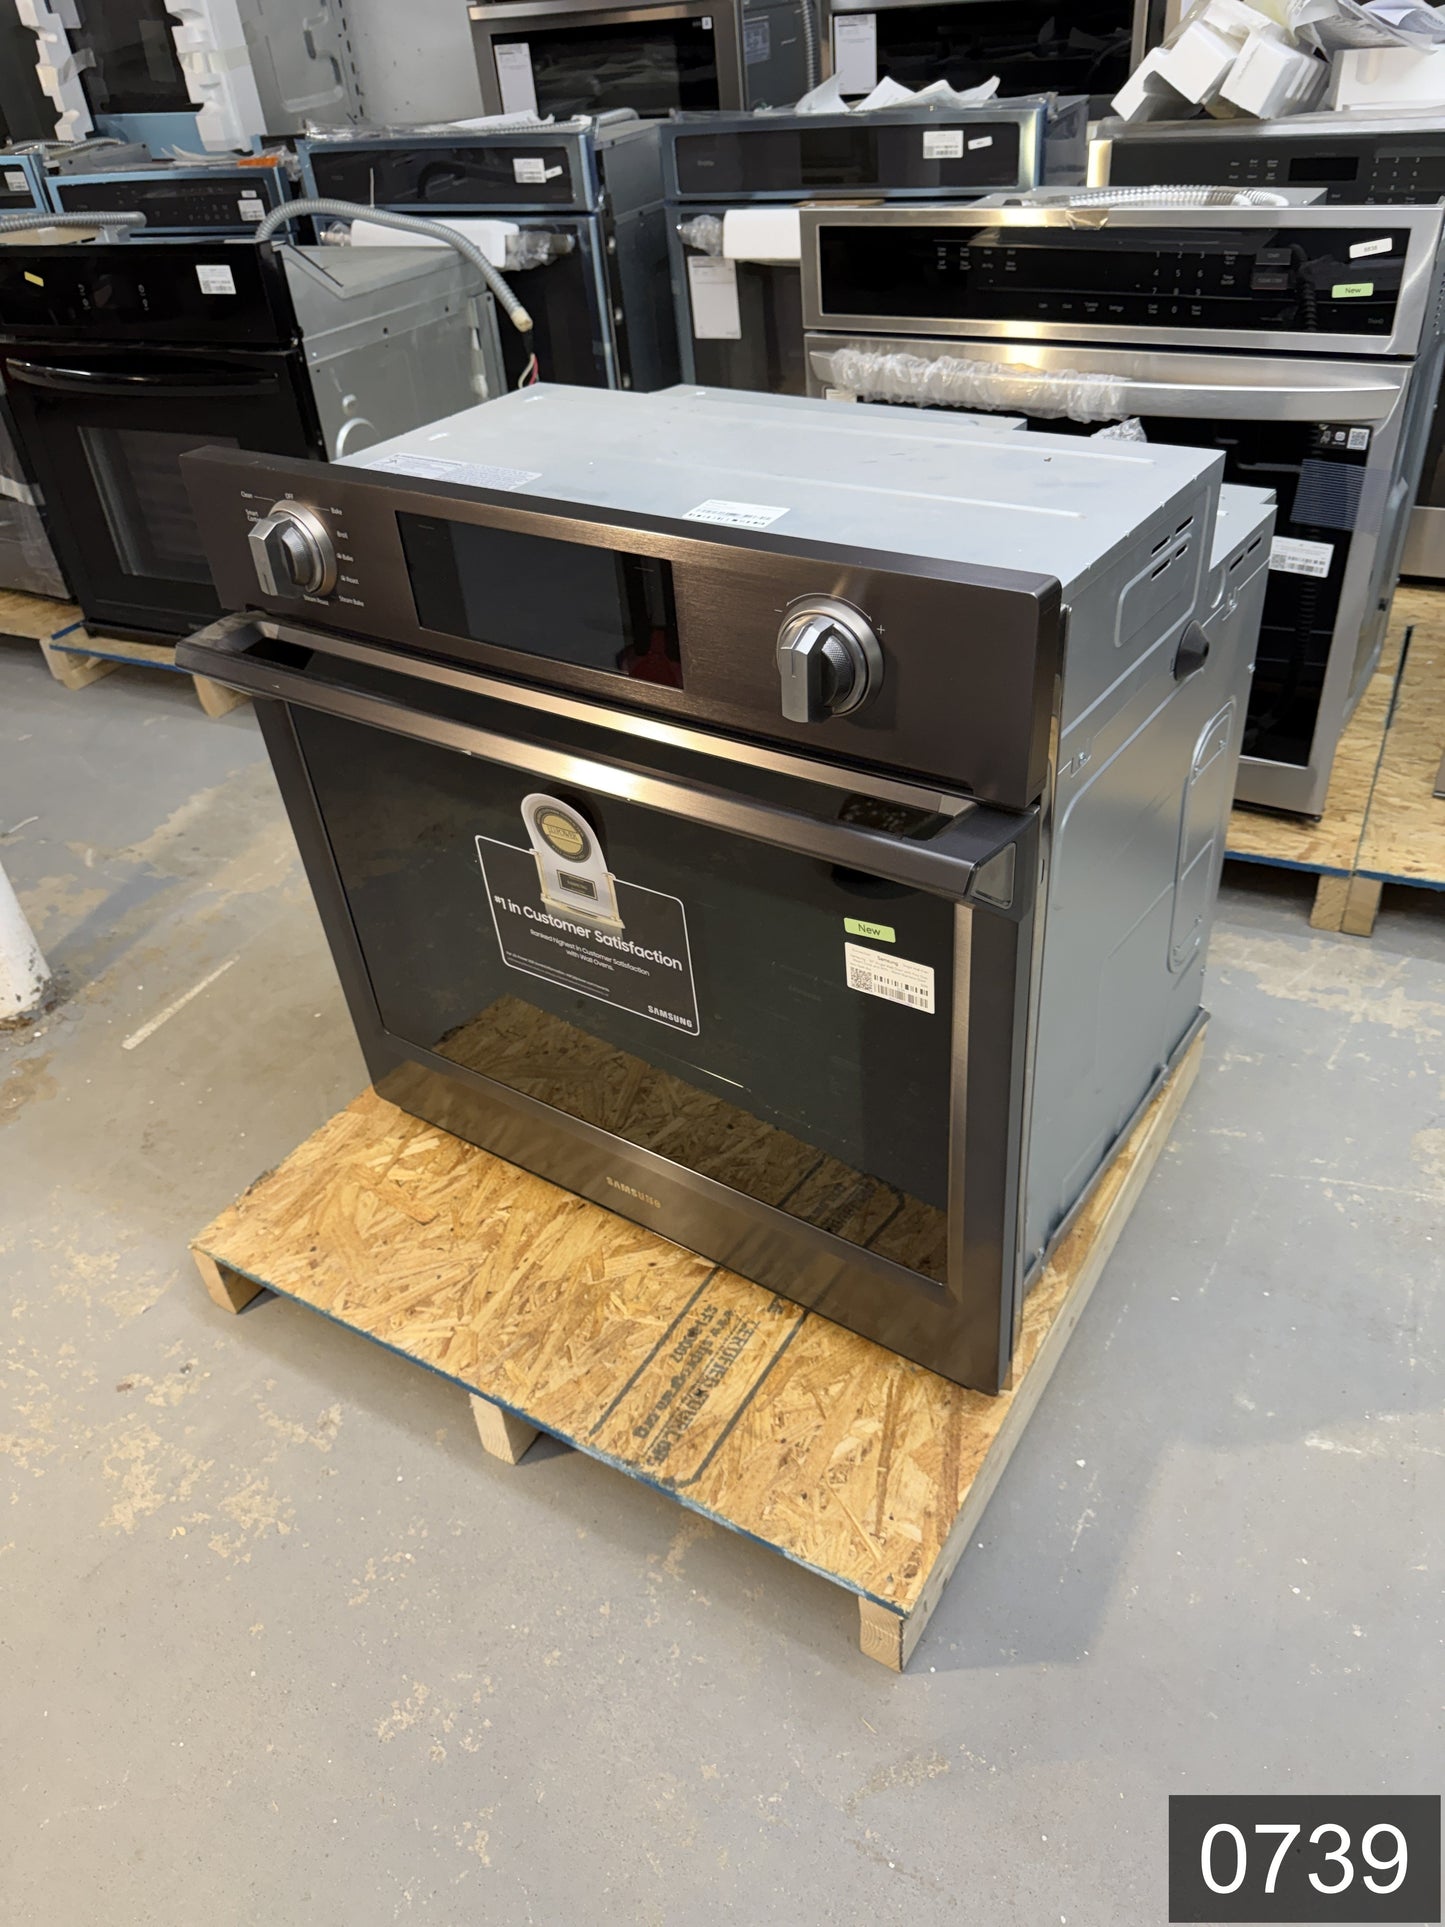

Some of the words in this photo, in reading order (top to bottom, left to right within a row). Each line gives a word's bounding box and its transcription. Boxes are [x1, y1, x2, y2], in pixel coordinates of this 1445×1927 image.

[1345, 287, 1362, 295] New
[494, 895, 507, 910] #1
[507, 898, 522, 915] in
[522, 905, 592, 939] Customer
[593, 929, 683, 972] Satisfaction
[858, 923, 881, 936] New
[581, 947, 612, 963] Customer
[612, 958, 650, 977] Satisfaction
[646, 1004, 694, 1029] SAMSUNG
[606, 1176, 661, 1209] SAMSUNG
